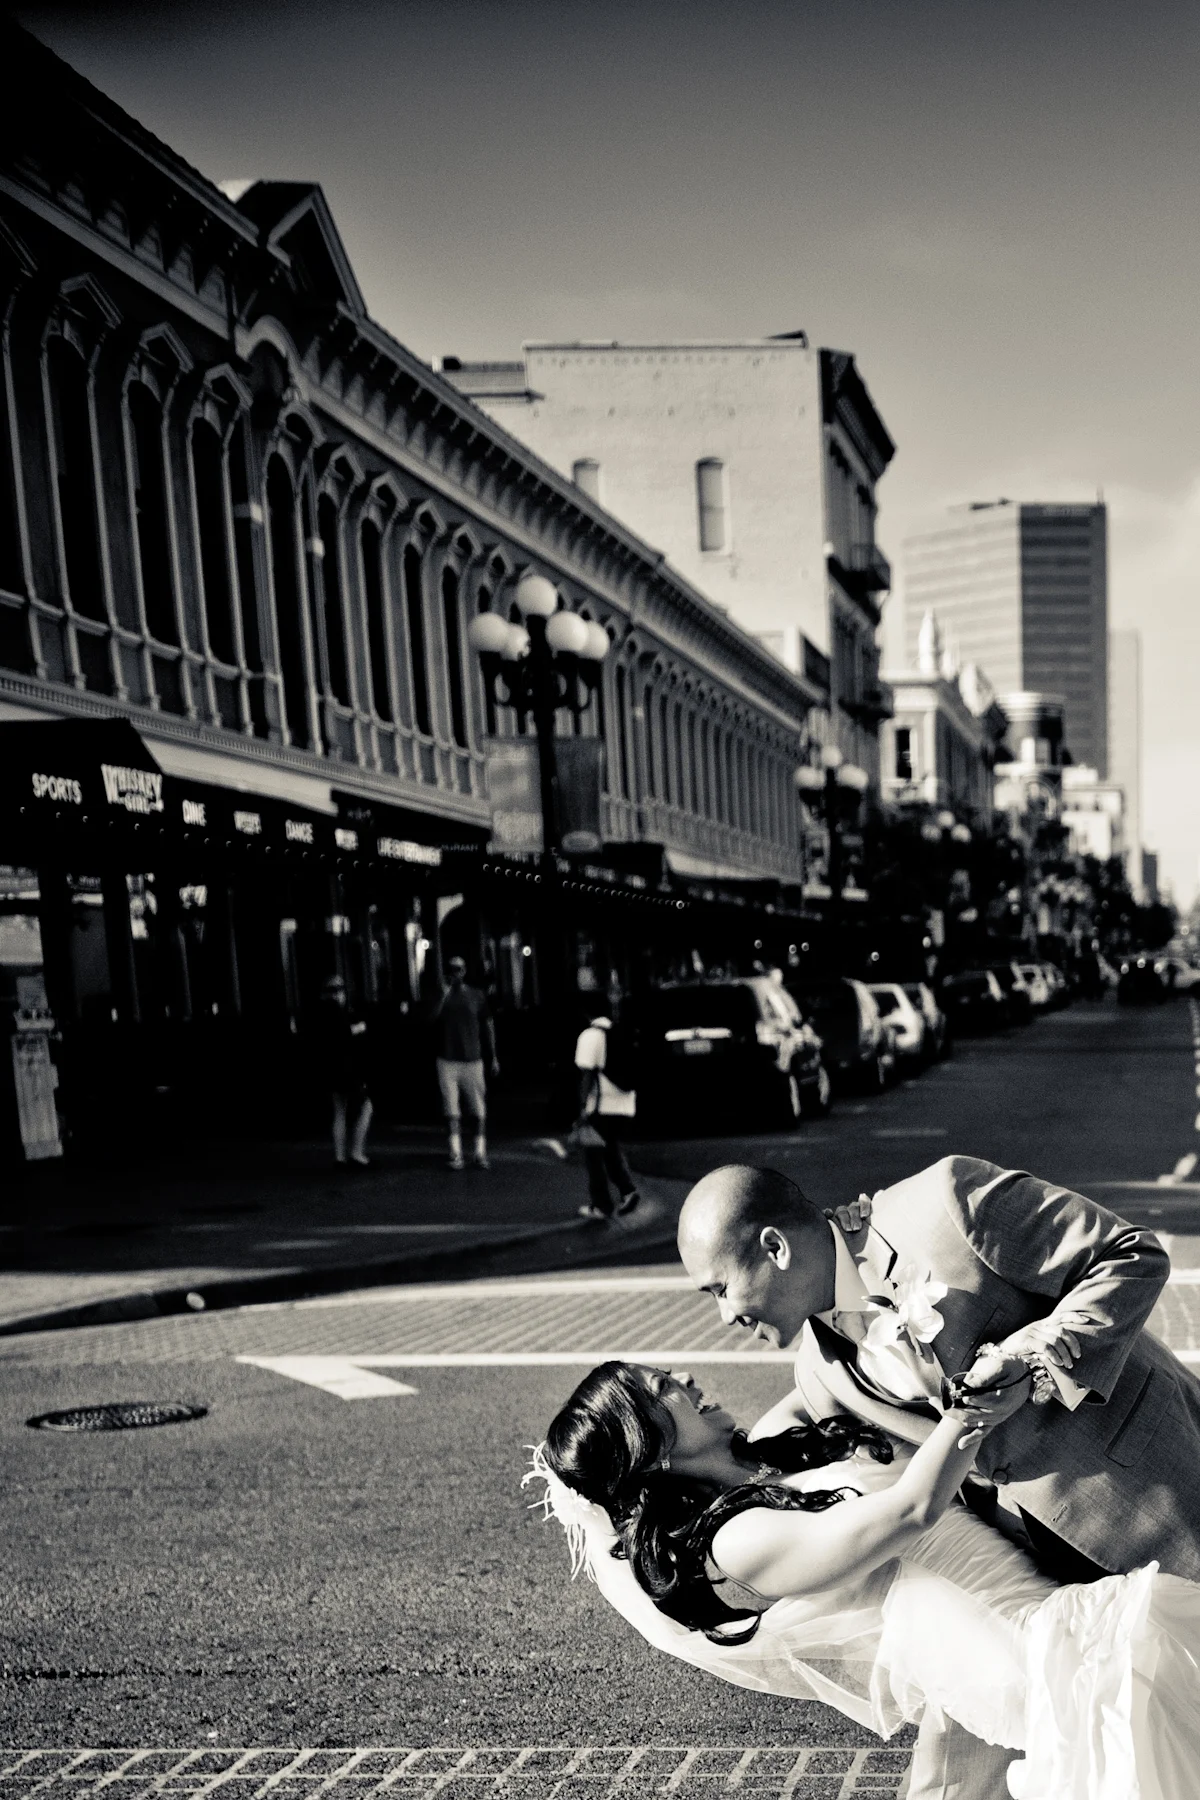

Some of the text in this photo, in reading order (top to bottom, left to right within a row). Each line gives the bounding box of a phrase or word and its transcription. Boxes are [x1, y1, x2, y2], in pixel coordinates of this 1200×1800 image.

[32, 772, 82, 805] SPORTS
[100, 763, 163, 804] WHISKEY
[124, 792, 150, 814] GIRL
[182, 799, 206, 826] DINE
[285, 819, 314, 844] DANCE
